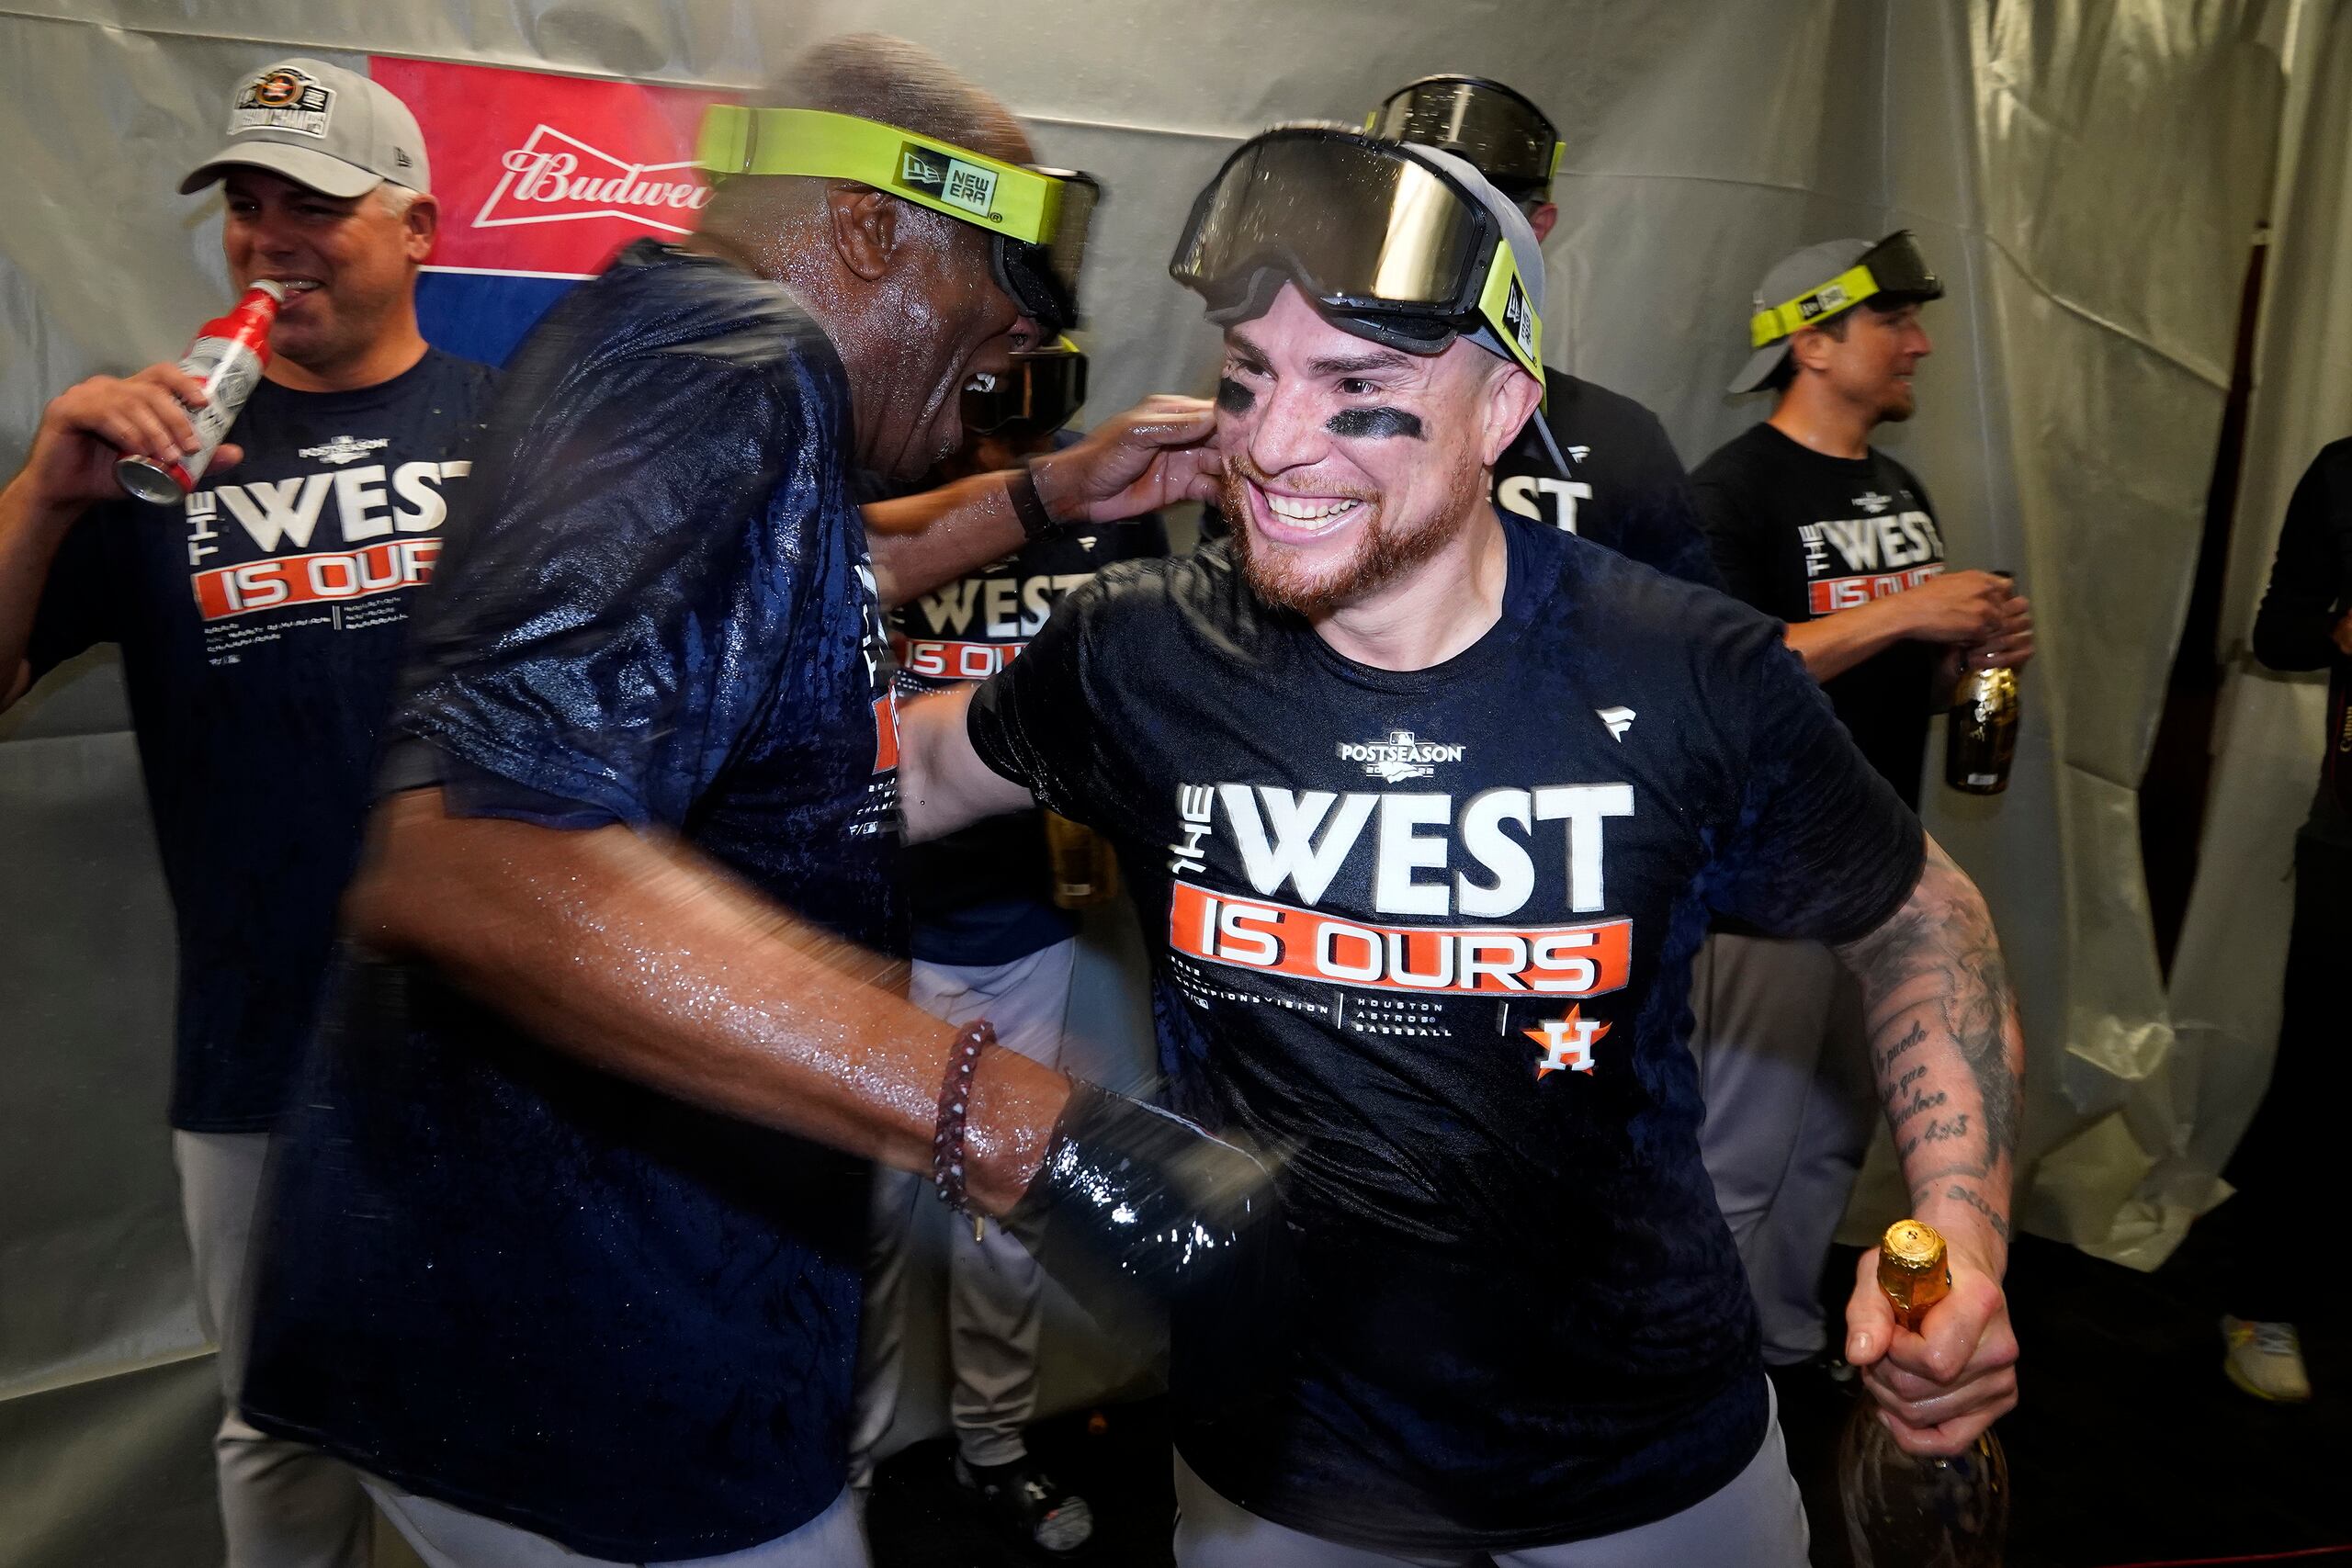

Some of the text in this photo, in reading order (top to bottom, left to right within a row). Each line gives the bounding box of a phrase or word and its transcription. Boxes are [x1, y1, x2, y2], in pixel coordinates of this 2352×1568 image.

[502, 150, 715, 210] Budwei
[949, 183, 986, 206] ERA
[952, 169, 989, 192] NEW
[185, 491, 219, 566] THE
[1498, 476, 1593, 536] ST
[1798, 525, 1830, 577] THE
[220, 563, 288, 613] IS
[1829, 579, 1870, 609] IS
[906, 642, 945, 675] IS
[1171, 783, 1215, 875] THE
[1217, 783, 1635, 919] WEST
[1202, 897, 1283, 966] IS
[1316, 921, 1600, 993] OURS
[1357, 998, 1442, 1011] HOUSTON
[1355, 1023, 1452, 1037] BASEBALL
[1540, 1021, 1600, 1071] H
